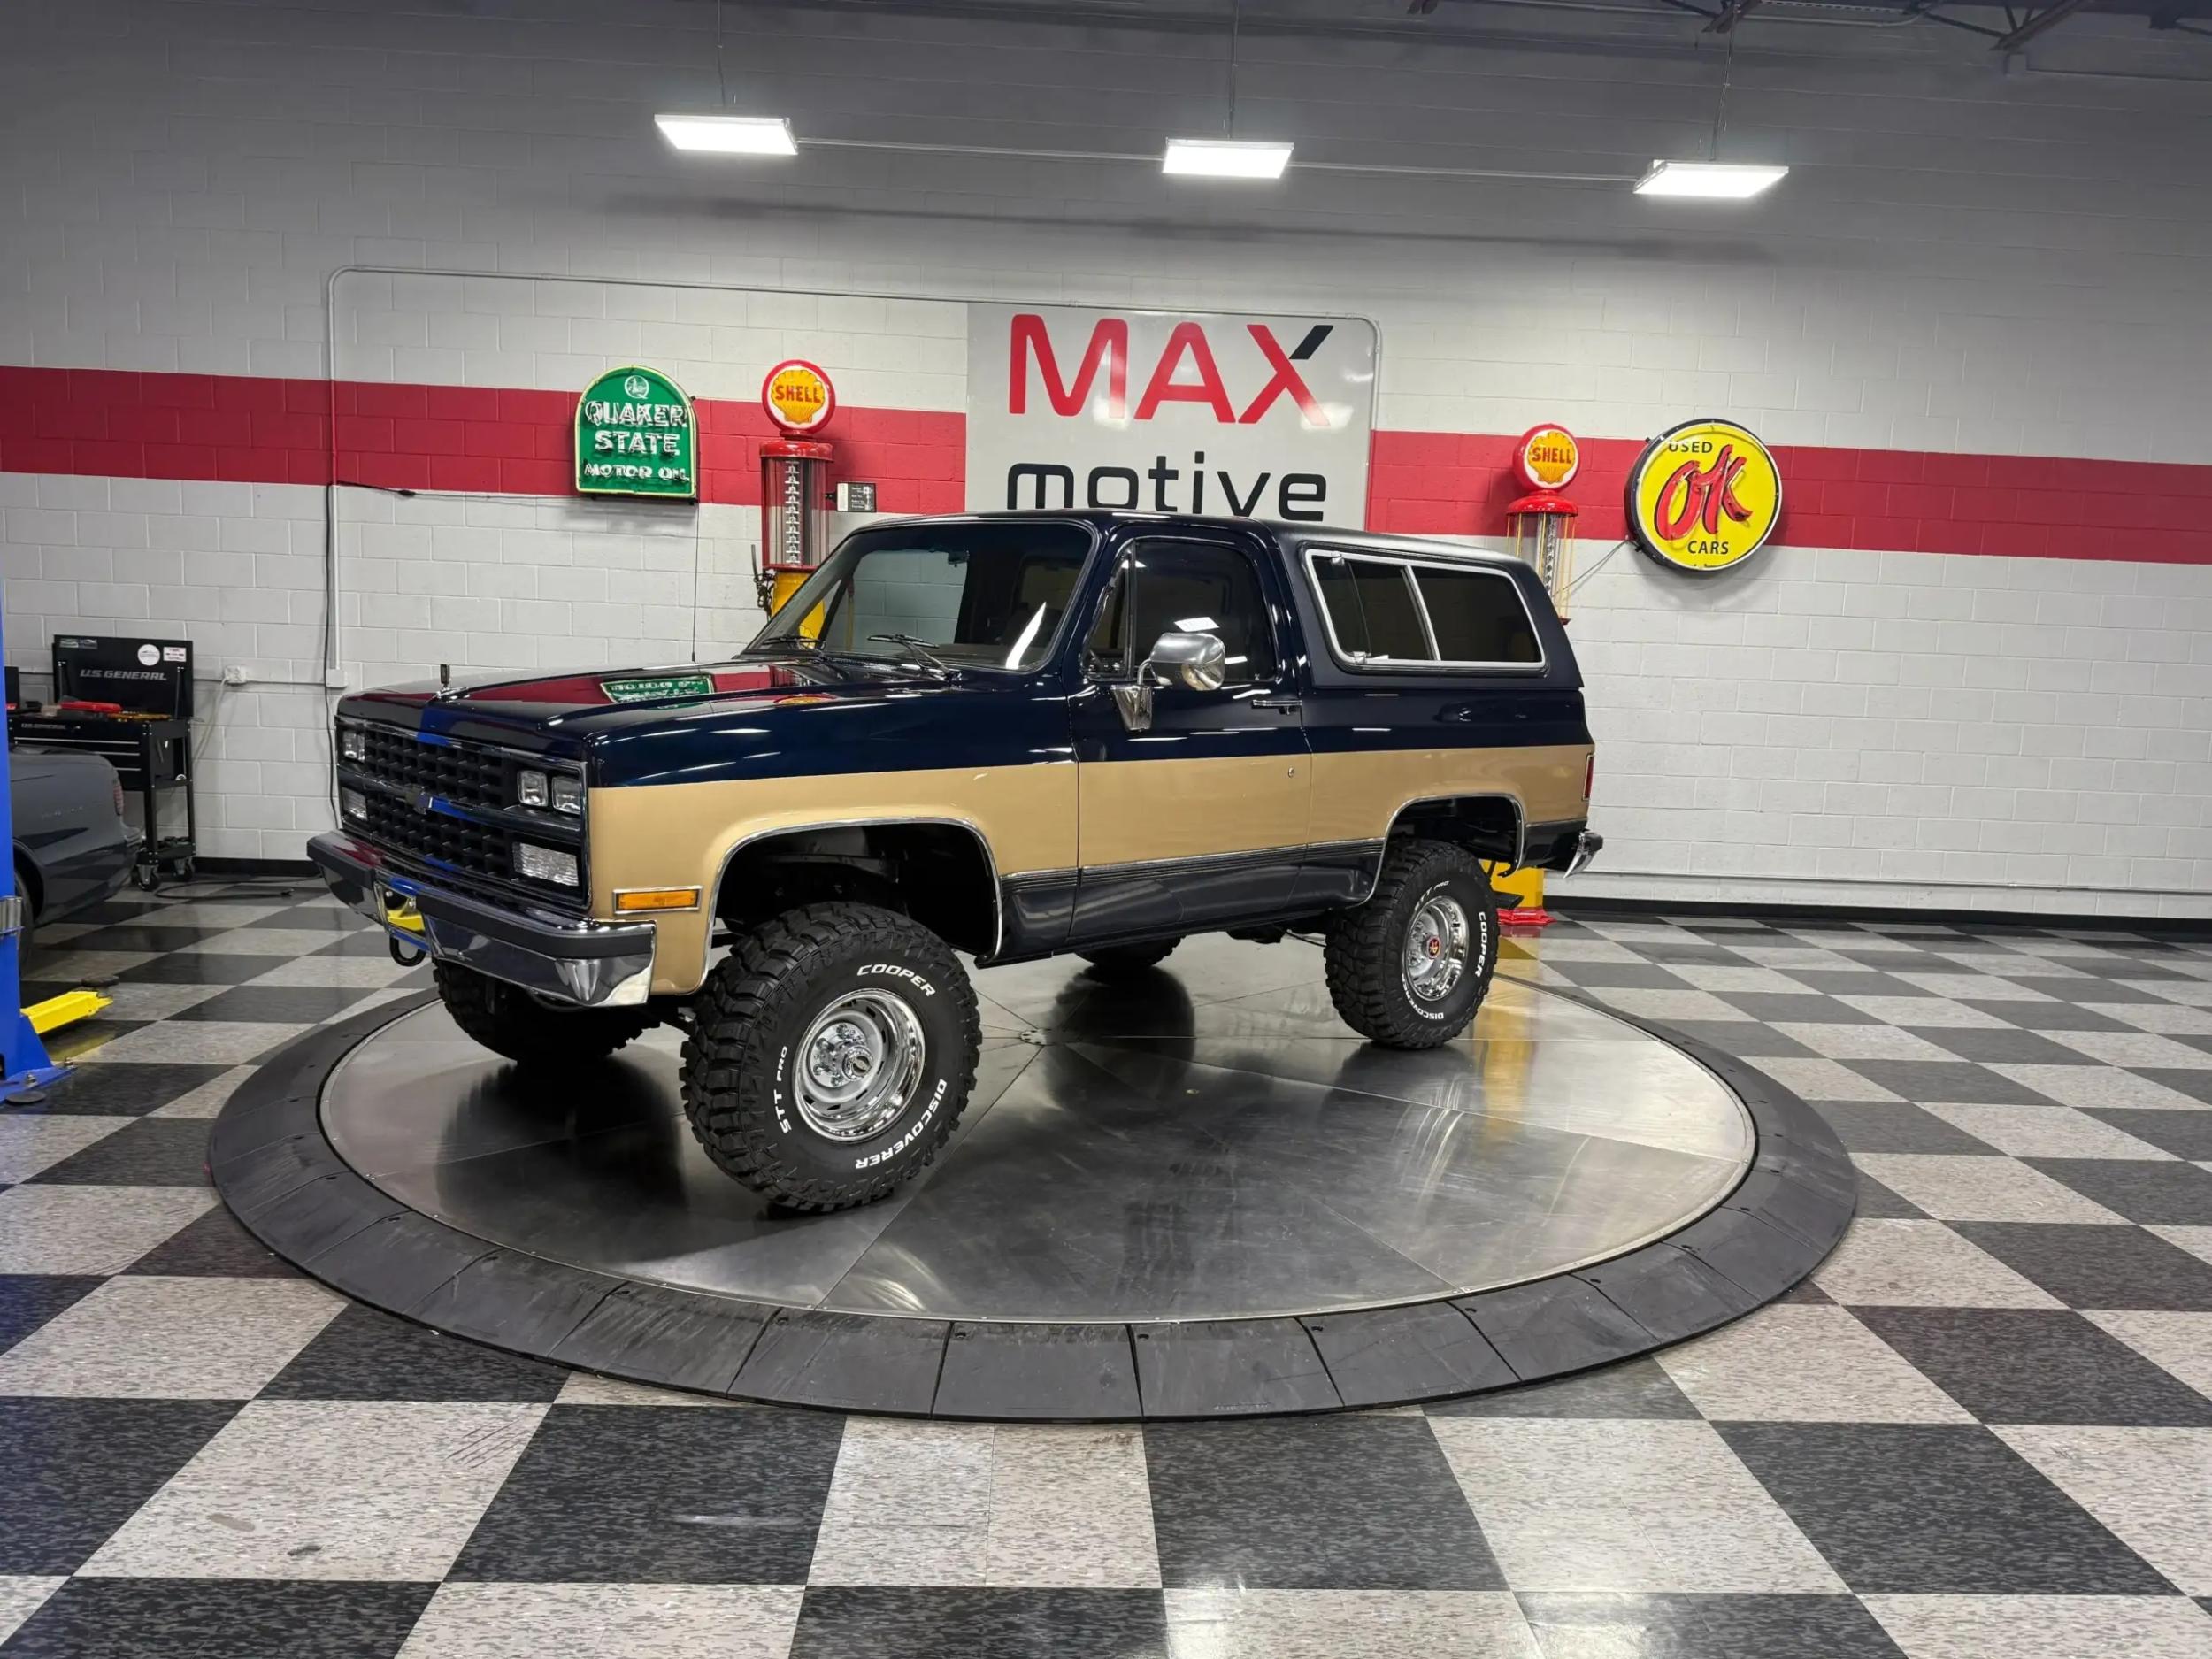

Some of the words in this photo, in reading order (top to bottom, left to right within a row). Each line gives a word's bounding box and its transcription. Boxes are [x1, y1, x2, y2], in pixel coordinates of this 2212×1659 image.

[1009, 313, 1334, 426] MAX
[775, 384, 822, 403] SHELL
[585, 400, 687, 427] QUAKER
[595, 430, 680, 456] STATE
[1531, 446, 1573, 465] SHELL
[1668, 440, 1713, 454] USED
[584, 463, 653, 479] MOTOR
[658, 466, 690, 482] OIL
[1007, 450, 1327, 523] motive
[1653, 443, 1754, 541] OK
[1687, 540, 1729, 555] CARS
[104, 670, 167, 680] GENERAL
[1474, 911, 1487, 978] COOPER
[856, 964, 936, 997] COOPER
[776, 1046, 788, 1082] PRO
[773, 1089, 792, 1133] STT
[855, 1079, 948, 1170] DISCOVERER
